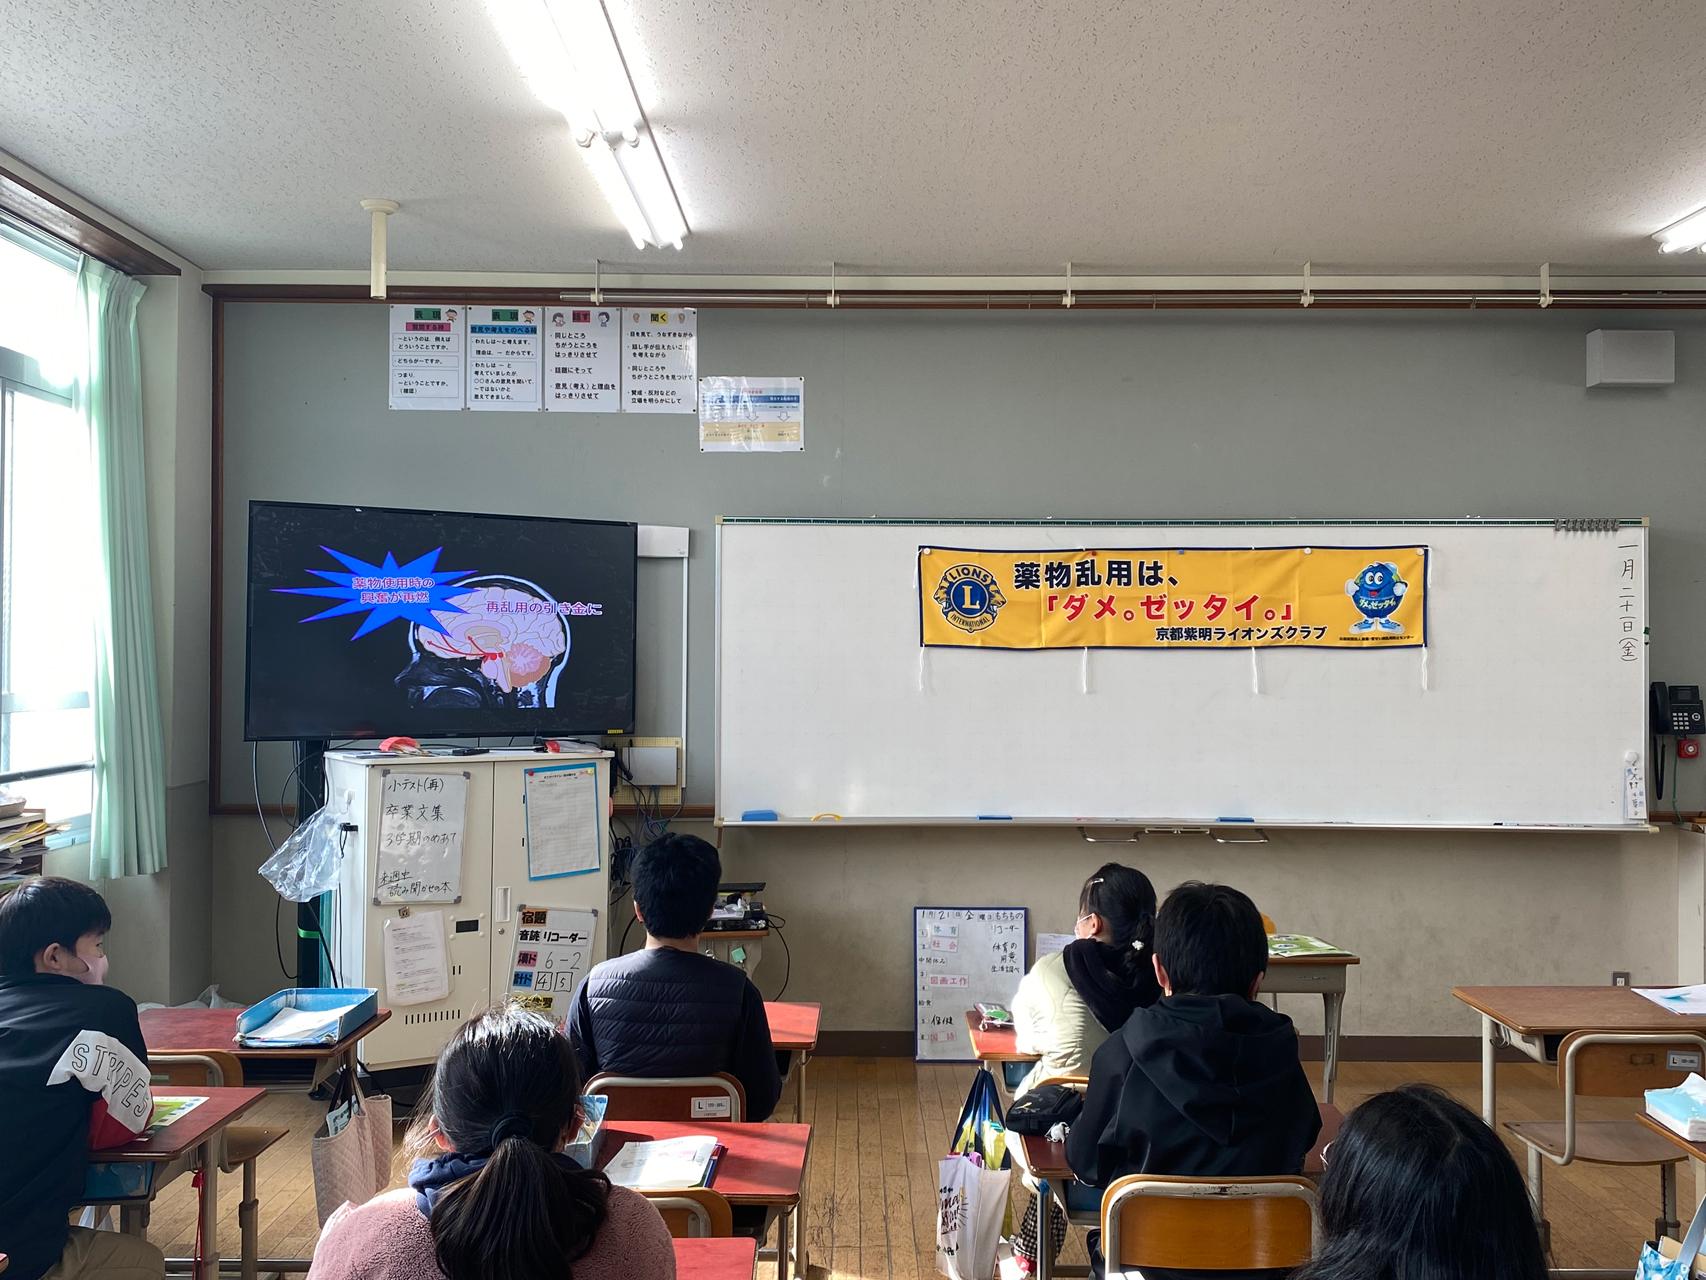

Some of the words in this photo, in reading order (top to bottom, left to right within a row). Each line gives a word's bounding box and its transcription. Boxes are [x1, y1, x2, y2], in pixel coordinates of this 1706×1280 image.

[650, 313, 667, 322] 聞く
[949, 566, 990, 583] LIONS
[1014, 560, 1178, 589] 薬物乱用は、
[352, 576, 435, 590] 薬物使用時の
[360, 591, 430, 604] 興奮が再燃
[962, 585, 980, 609] L
[486, 600, 603, 616] 再乱用の引き金に
[1047, 593, 1292, 622] 「ダメ。ゼッタイ。」
[950, 613, 991, 627] INTERNATIONAL
[1155, 626, 1328, 642] 京都紫明ライオンズクラブ
[388, 776, 444, 793] 小テスト(再)
[385, 803, 445, 822] 卒業文集
[521, 910, 547, 925] 宿題
[996, 911, 1024, 921] もちもの
[519, 929, 541, 942] 音読
[543, 931, 588, 944] リコーダー
[932, 941, 958, 950] 社会
[993, 942, 1018, 953] 体育の
[537, 973, 548, 988] 4
[560, 977, 567, 988] 5
[930, 976, 967, 986] 図画工作
[698, 1101, 703, 1110] L
